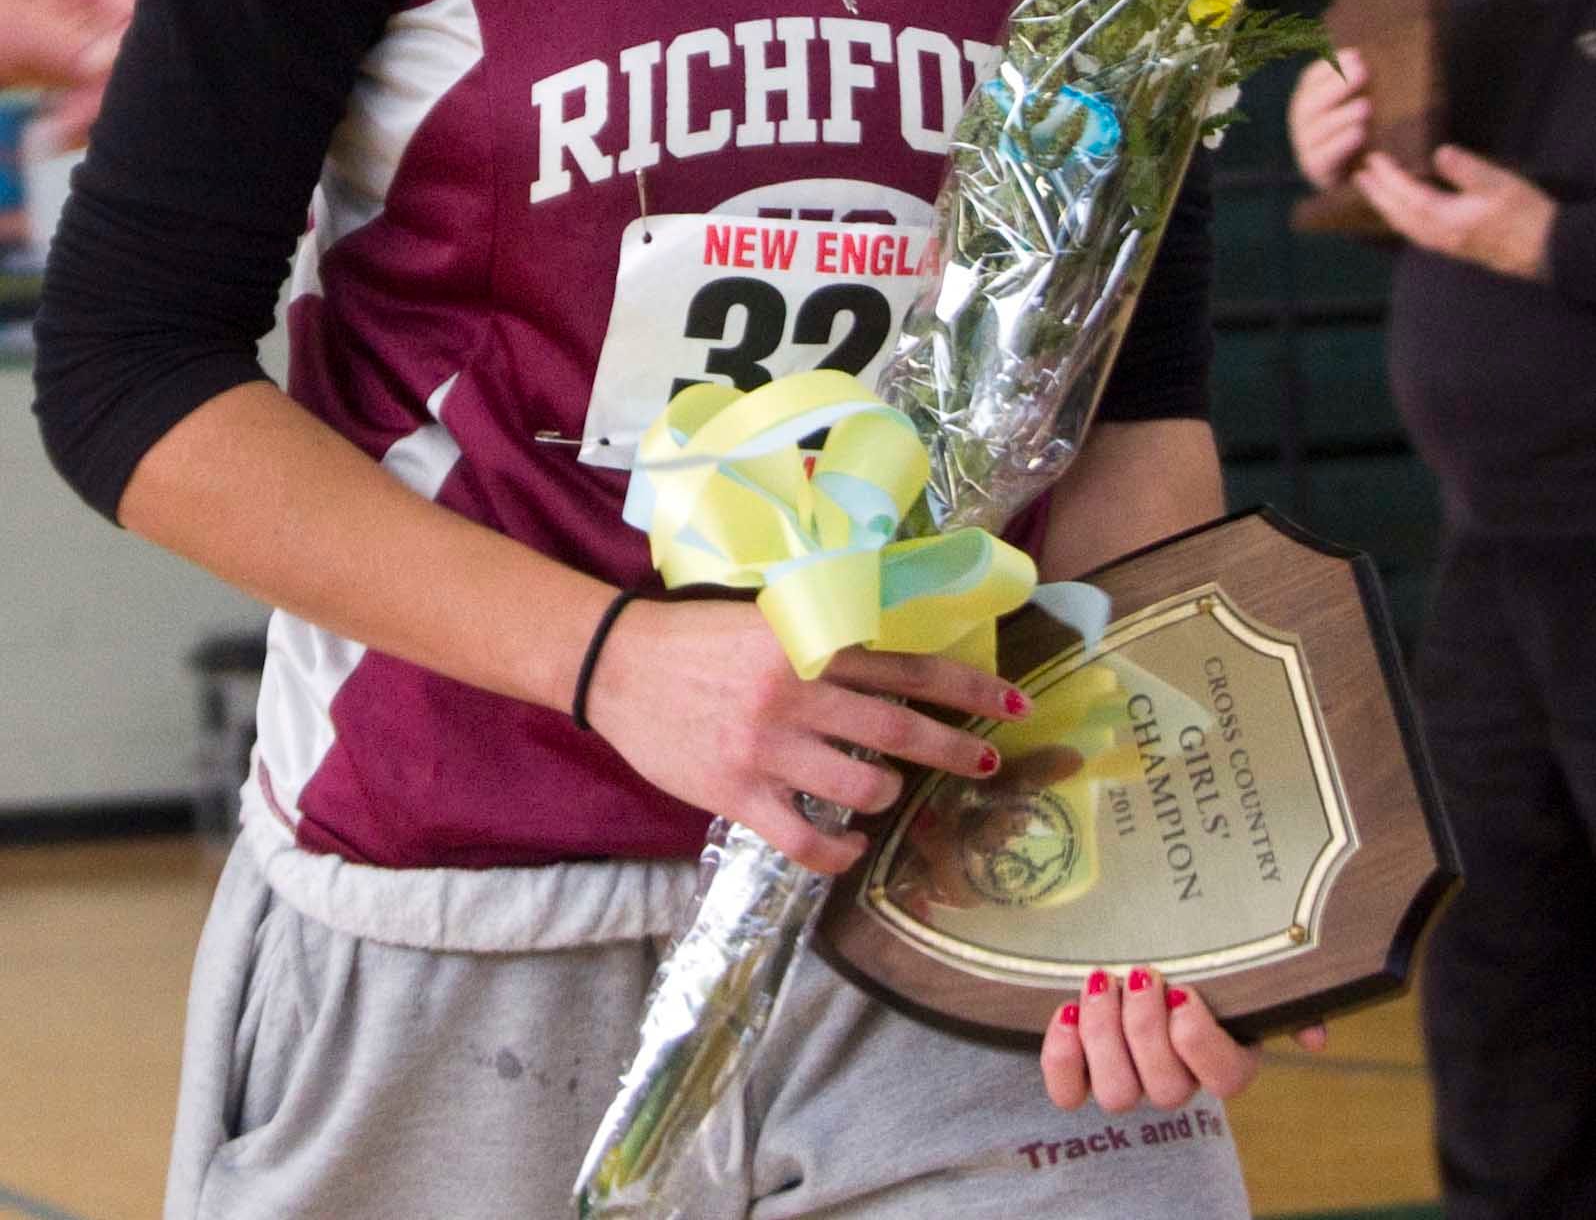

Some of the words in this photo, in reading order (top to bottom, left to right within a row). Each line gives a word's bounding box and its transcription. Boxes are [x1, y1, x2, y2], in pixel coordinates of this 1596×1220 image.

[703, 224, 798, 271] NEW
[668, 277, 930, 448] 32
[1109, 786, 1137, 837] 2011
[1127, 693, 1203, 901] CHAMPION
[1179, 725, 1231, 839] GIRLS'
[1205, 656, 1242, 742] CROSS
[1229, 749, 1281, 882] COUNTRY
[1017, 1126, 1131, 1169] Track
[1140, 1112, 1193, 1145] and
